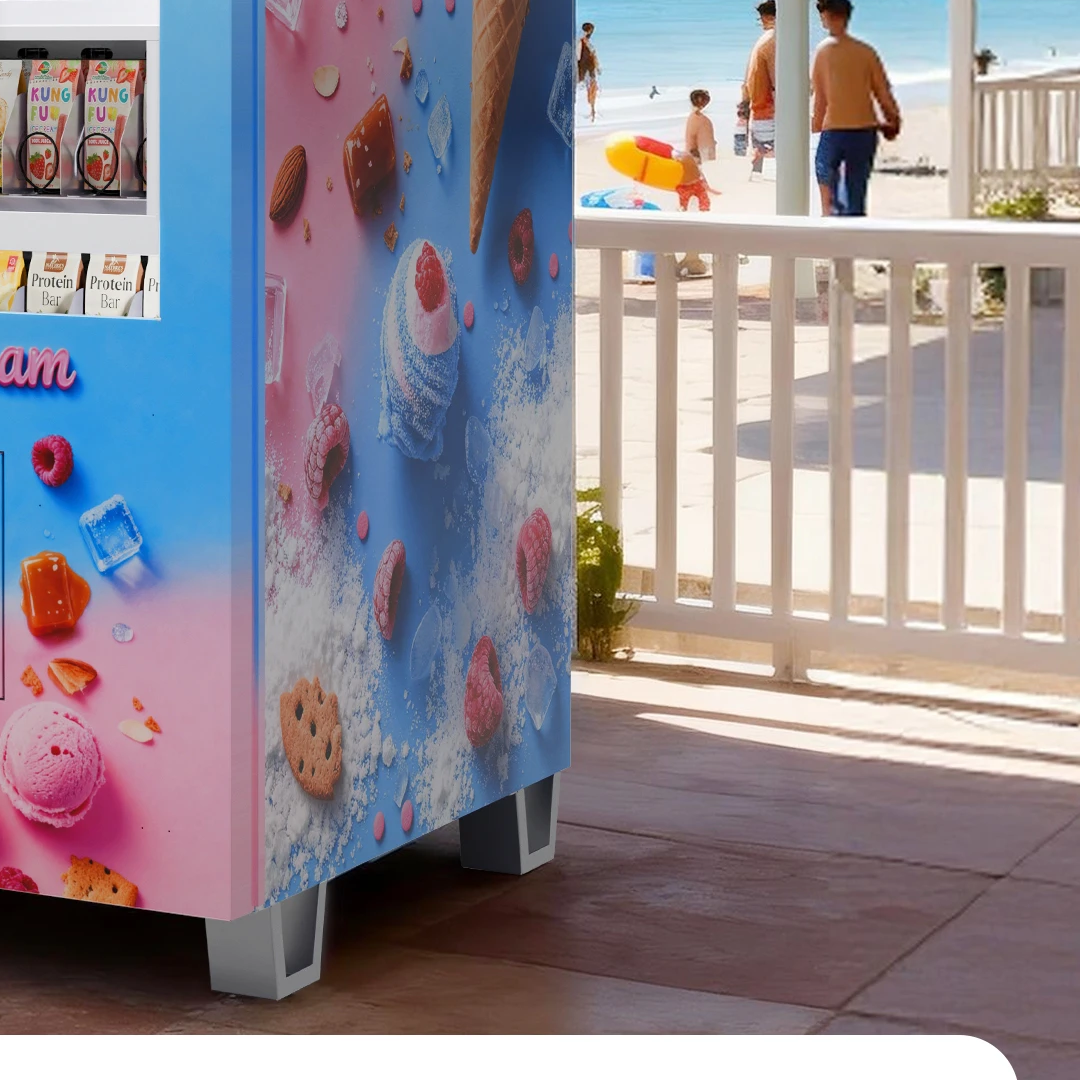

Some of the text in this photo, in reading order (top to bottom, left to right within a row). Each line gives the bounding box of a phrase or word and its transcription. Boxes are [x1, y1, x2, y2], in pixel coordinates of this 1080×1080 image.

[31, 86, 70, 103] KUNG
[88, 87, 129, 103] KUNG
[31, 273, 74, 289] Protein
[90, 275, 133, 291] Protein
[41, 291, 62, 307] Bar
[100, 293, 121, 309] Bar
